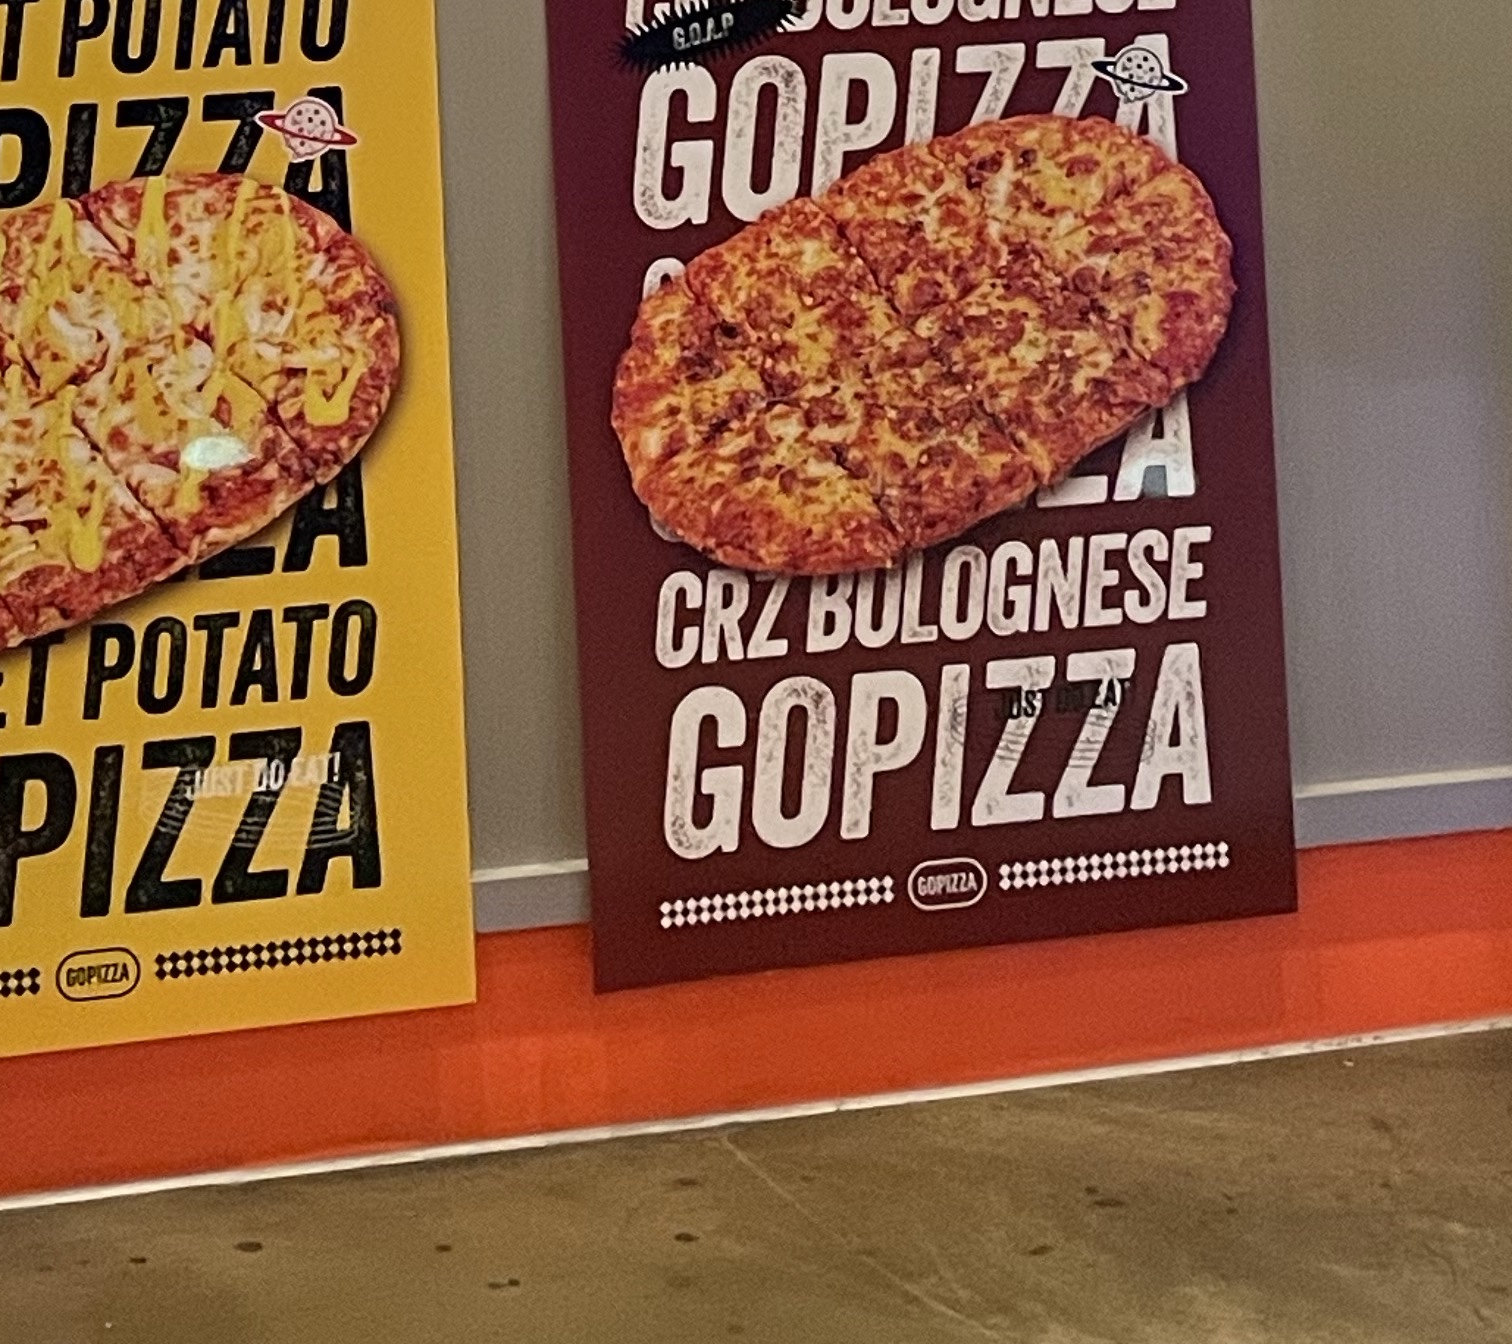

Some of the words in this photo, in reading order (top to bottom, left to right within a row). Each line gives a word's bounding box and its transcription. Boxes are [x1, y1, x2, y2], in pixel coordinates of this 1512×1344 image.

[655, 569, 792, 669] CRZ
[805, 525, 1213, 654] BOLOGNESE
[82, 598, 378, 721] POTATO
[662, 642, 1213, 860] GOPIZZA
[917, 872, 978, 897] GOPIZZA
[66, 962, 130, 987] GOPIZZA
